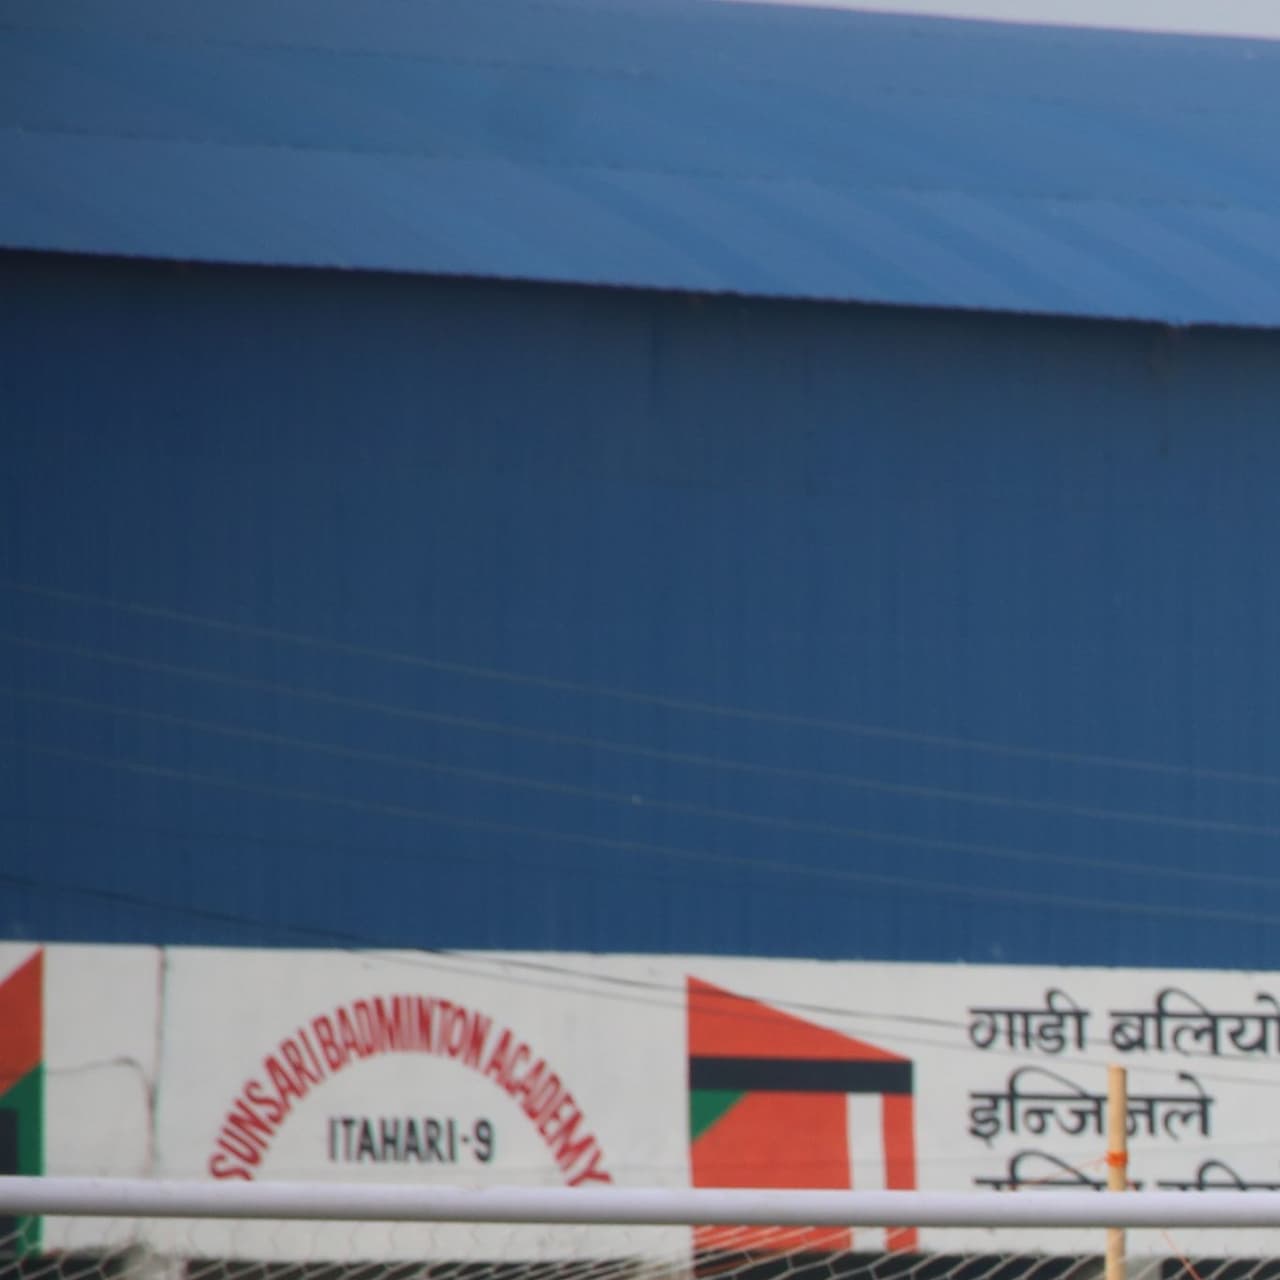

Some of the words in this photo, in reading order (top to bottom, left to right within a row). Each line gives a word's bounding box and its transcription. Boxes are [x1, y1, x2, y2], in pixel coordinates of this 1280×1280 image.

[208, 1026, 326, 1181] SUNSARI
[311, 993, 492, 1073] BADMINTON
[484, 1026, 613, 1187] ACADEMY
